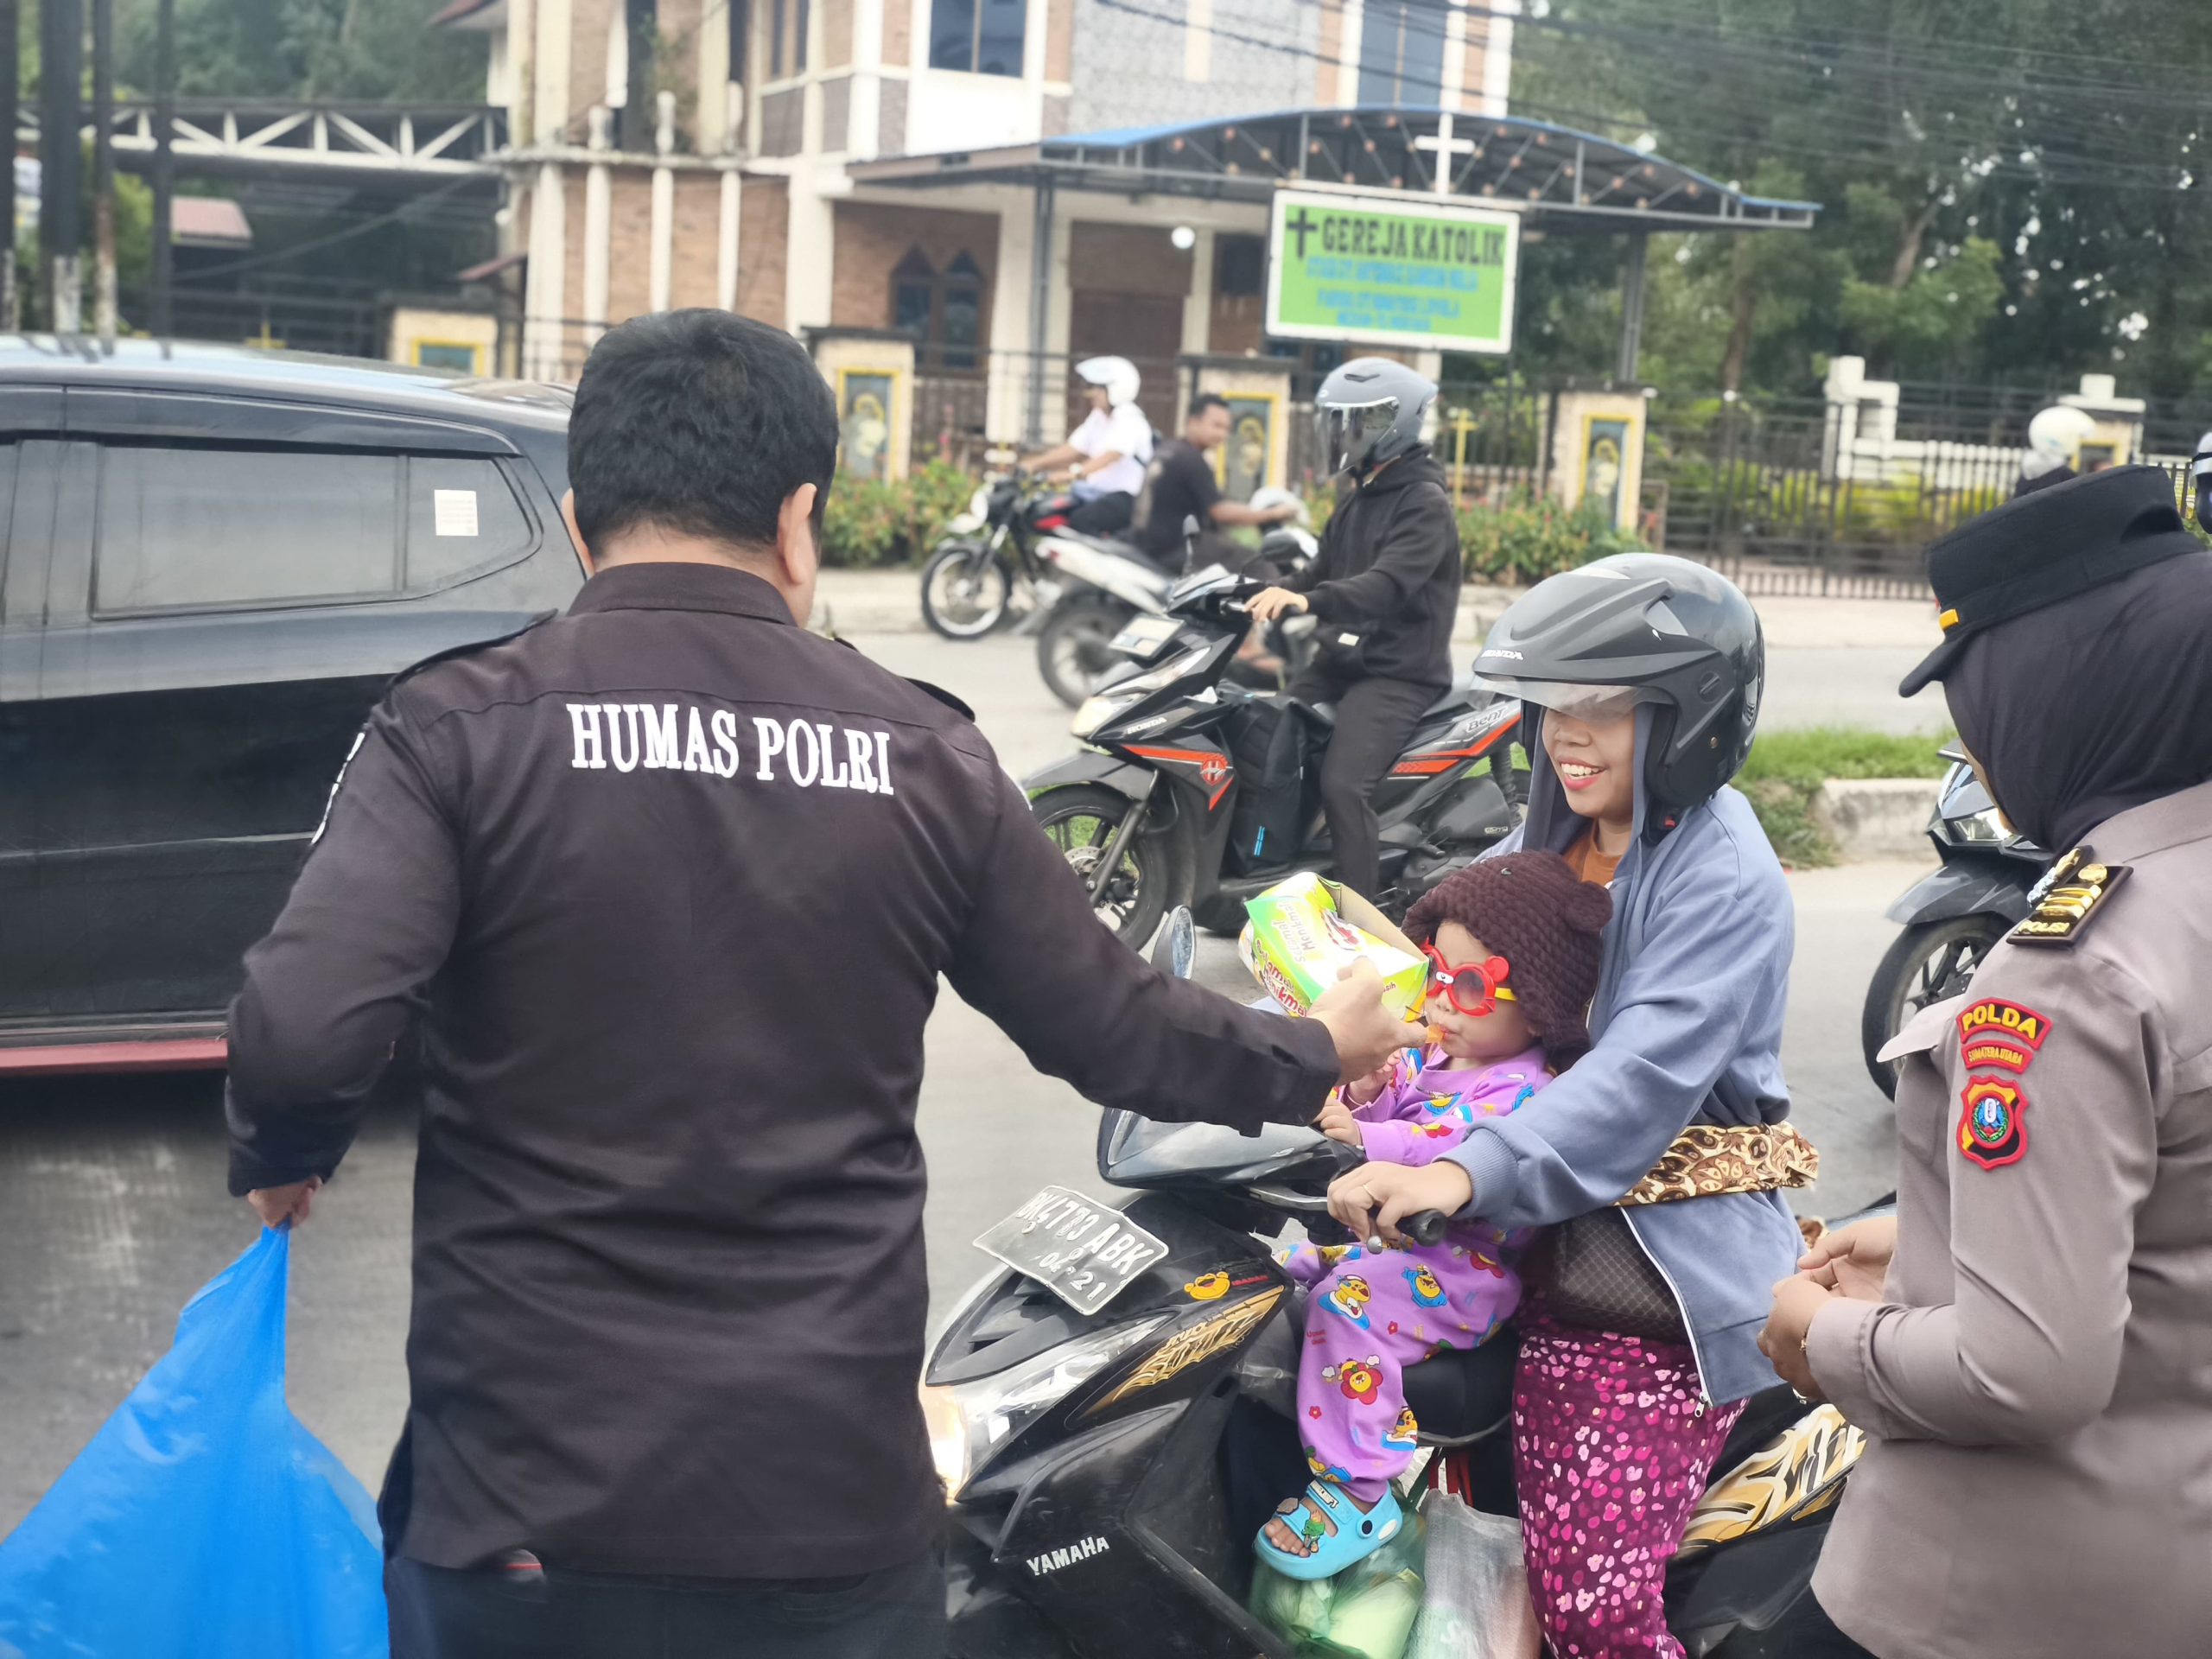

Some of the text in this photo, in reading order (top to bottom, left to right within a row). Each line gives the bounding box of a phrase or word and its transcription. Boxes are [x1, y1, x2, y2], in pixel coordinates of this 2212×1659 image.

[1322, 216, 1506, 265] GEREJA KATOLIK
[565, 702, 894, 796] HUMAS POLRI
[1961, 1002, 2037, 1039] POLDA
[1083, 1222, 1155, 1276] ABK
[1026, 1536, 1110, 1577] YAMAHA
